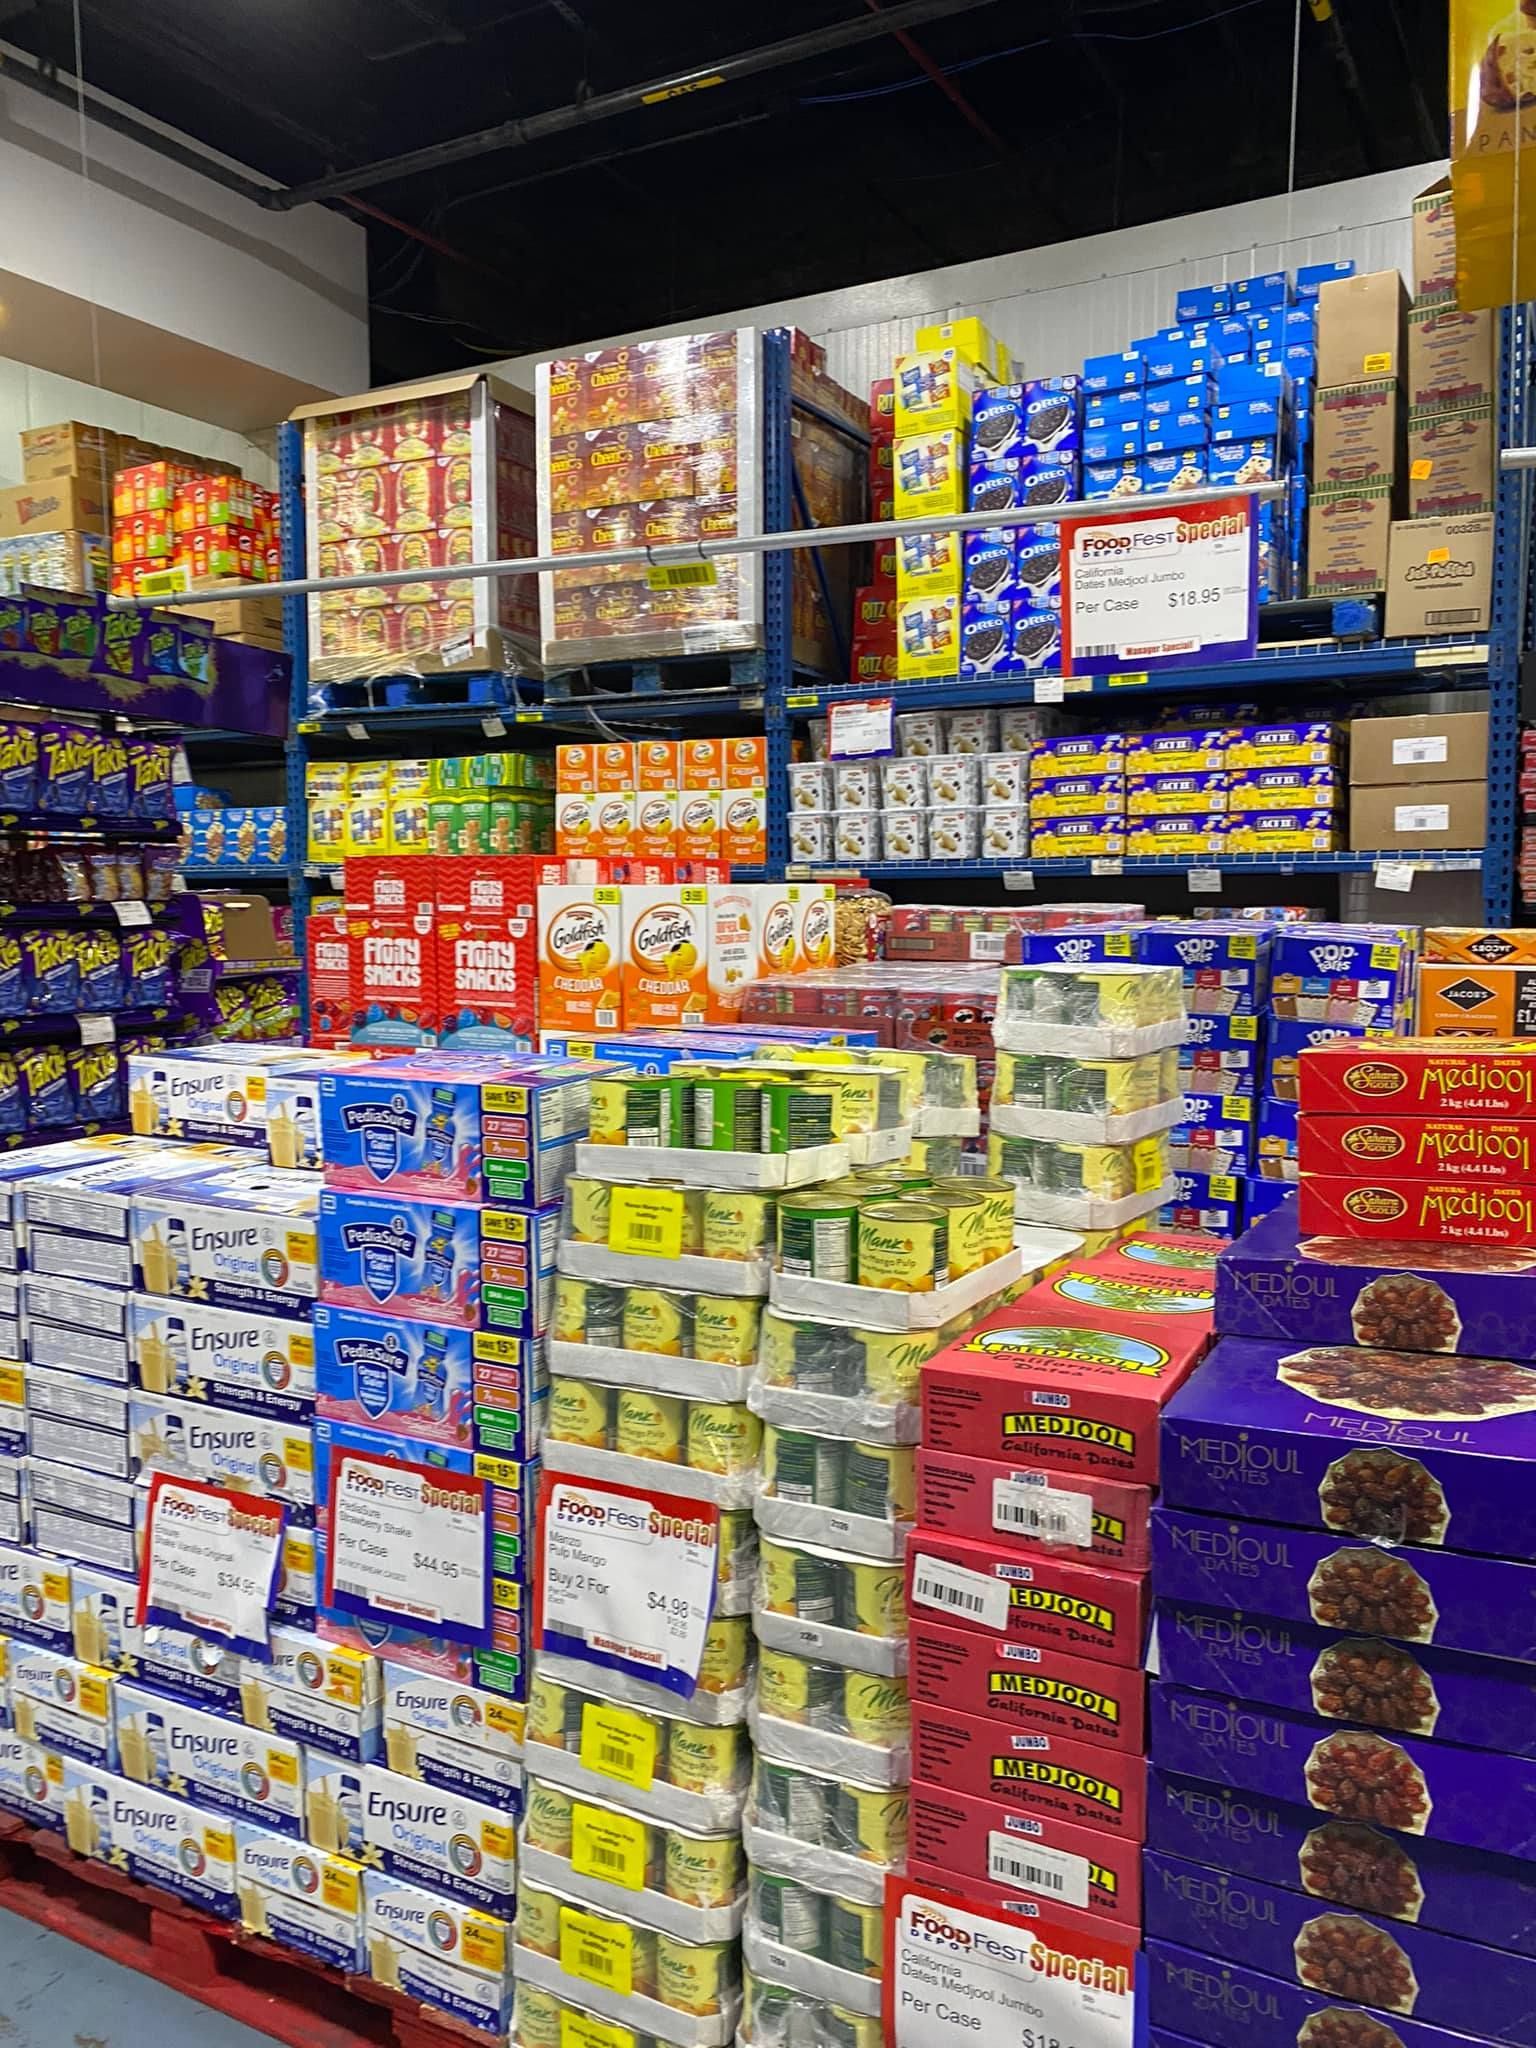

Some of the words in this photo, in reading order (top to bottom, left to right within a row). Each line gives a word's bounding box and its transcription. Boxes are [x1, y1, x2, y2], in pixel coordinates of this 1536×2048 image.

[975, 403, 1016, 422] OREO
[1027, 395, 1070, 414] OREO
[972, 476, 1013, 496] OREO
[1024, 468, 1066, 488] OREO
[1082, 536, 1132, 551] FOOD
[1176, 513, 1246, 543] Special
[968, 548, 1009, 567] OREO
[1083, 548, 1132, 558] DEPOT
[1075, 566, 1124, 580] California
[1075, 579, 1105, 591] Dates
[1108, 575, 1148, 589] Medjool
[1151, 571, 1185, 584] Jumbo
[862, 602, 886, 622] RITZ
[1075, 601, 1100, 614] Per
[1104, 599, 1139, 612] Case
[1168, 588, 1221, 608] $18.95
[964, 619, 1004, 635] OREO
[1015, 613, 1056, 631] OREO
[598, 891, 604, 902] 3
[685, 891, 691, 902] 3
[554, 920, 606, 949] Goldfish
[638, 920, 692, 950] Goldfish
[364, 965, 421, 987] SNACKS
[455, 968, 516, 992] SNACKS
[554, 976, 604, 992] CHEDDAR
[639, 978, 690, 995] CHEDDAR
[171, 1075, 225, 1097] Ensure
[1419, 1063, 1532, 1102] Medjool
[188, 1097, 224, 1113] Original
[1440, 1099, 1446, 1107] 2
[1449, 1098, 1463, 1108] kg
[347, 1108, 412, 1129] PediaSure
[1417, 1126, 1530, 1166] Medjool
[1438, 1162, 1444, 1170] 2
[1447, 1162, 1461, 1172] kg
[1419, 1189, 1532, 1228] Medjool
[191, 1227, 259, 1251] Ensure
[347, 1228, 412, 1250] PediaSure
[1440, 1225, 1446, 1233] 2
[1449, 1224, 1463, 1234] kg
[214, 1253, 259, 1274] Original
[214, 1282, 254, 1300] Strength
[257, 1288, 264, 1299] &
[265, 1290, 300, 1308] Energy
[191, 1328, 259, 1351] Ensure
[214, 1353, 259, 1374] Original
[341, 1343, 405, 1367] PediaSure
[214, 1381, 254, 1400] Strength
[257, 1390, 264, 1400] &
[265, 1392, 301, 1412] Energy
[1035, 1392, 1069, 1406] JUMBO
[189, 1426, 256, 1451] Ensure
[1014, 1417, 1127, 1449] MEDJOOL
[1002, 1439, 1081, 1462] California
[1086, 1451, 1135, 1470] Dates
[348, 1470, 384, 1490] FOOD
[421, 1481, 482, 1516] Special
[557, 1512, 606, 1528] DEPOT
[558, 1498, 606, 1520] FOOD
[649, 1511, 716, 1548] Special
[549, 1531, 582, 1548] Manzo
[338, 1533, 356, 1548] Per
[359, 1538, 388, 1558] Case
[413, 1552, 459, 1579] $44.95
[549, 1543, 570, 1560] Pulp
[571, 1548, 607, 1567] Mango
[548, 1567, 575, 1589] Buy
[576, 1575, 585, 1589] 2
[588, 1578, 610, 1595] For
[647, 1590, 689, 1619] $4.98
[1006, 1646, 1039, 1660] JUMBO
[1000, 1674, 1112, 1716] MEDJOOL
[987, 1697, 1067, 1725] California
[1070, 1716, 1118, 1739] Dates
[171, 1727, 238, 1756] Ensure
[1002, 1759, 1112, 1804] MEDJOOL
[114, 1804, 176, 1831] Ensure
[368, 1791, 447, 1825] Ensure
[392, 1824, 448, 1857] Original
[393, 1851, 439, 1879] Strength
[441, 1872, 450, 1885] &
[453, 1875, 493, 1903] Energy
[376, 1900, 424, 1923] Ensure
[910, 1928, 972, 1955] DEPOT
[911, 1911, 971, 1944] FOOD
[1029, 1941, 1129, 1995] Special
[901, 1948, 961, 1979] California
[901, 1963, 939, 1986] Dates
[941, 1976, 995, 2003] Medjool
[997, 1993, 1044, 2019] Jumbo
[901, 1990, 931, 2014] Per
[936, 2002, 981, 2031] Case
